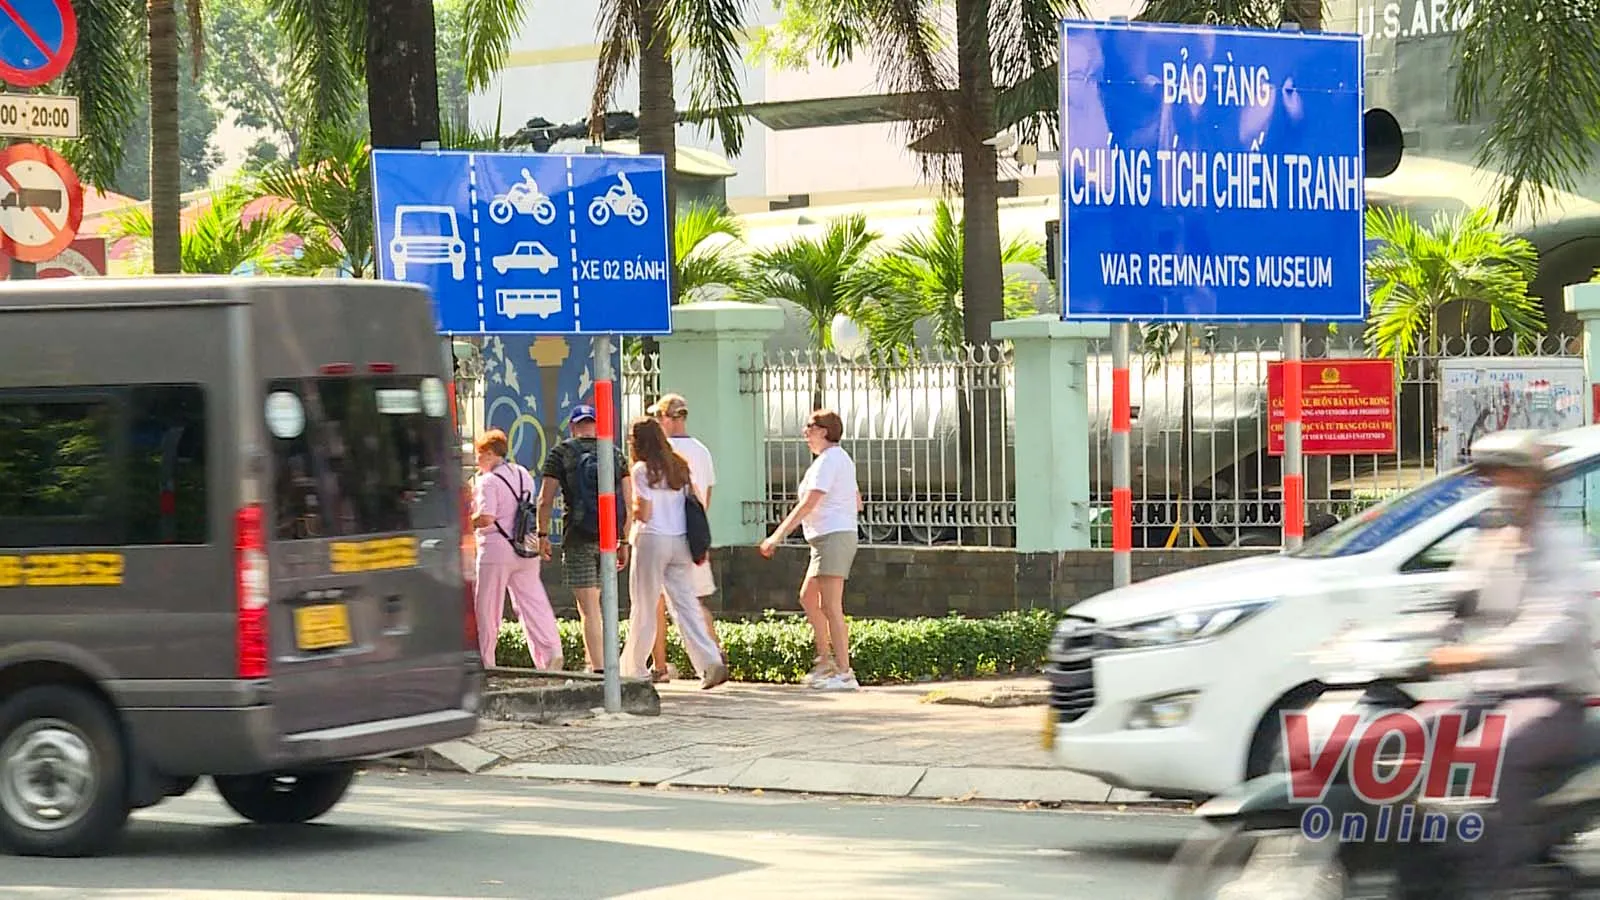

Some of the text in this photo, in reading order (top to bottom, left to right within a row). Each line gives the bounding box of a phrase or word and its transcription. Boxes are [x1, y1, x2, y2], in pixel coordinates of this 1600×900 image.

[1357, 0, 1476, 41] U.S.ARM
[1163, 48, 1270, 107] BẢO TÀNG
[31, 106, 69, 128] 20:00
[1069, 132, 1359, 210] CHỨNG TÍCH CHIẾN TRANH
[580, 254, 665, 280] XE 02 BÁNH
[1100, 253, 1333, 288] WAR REMNANTS MUSEUM
